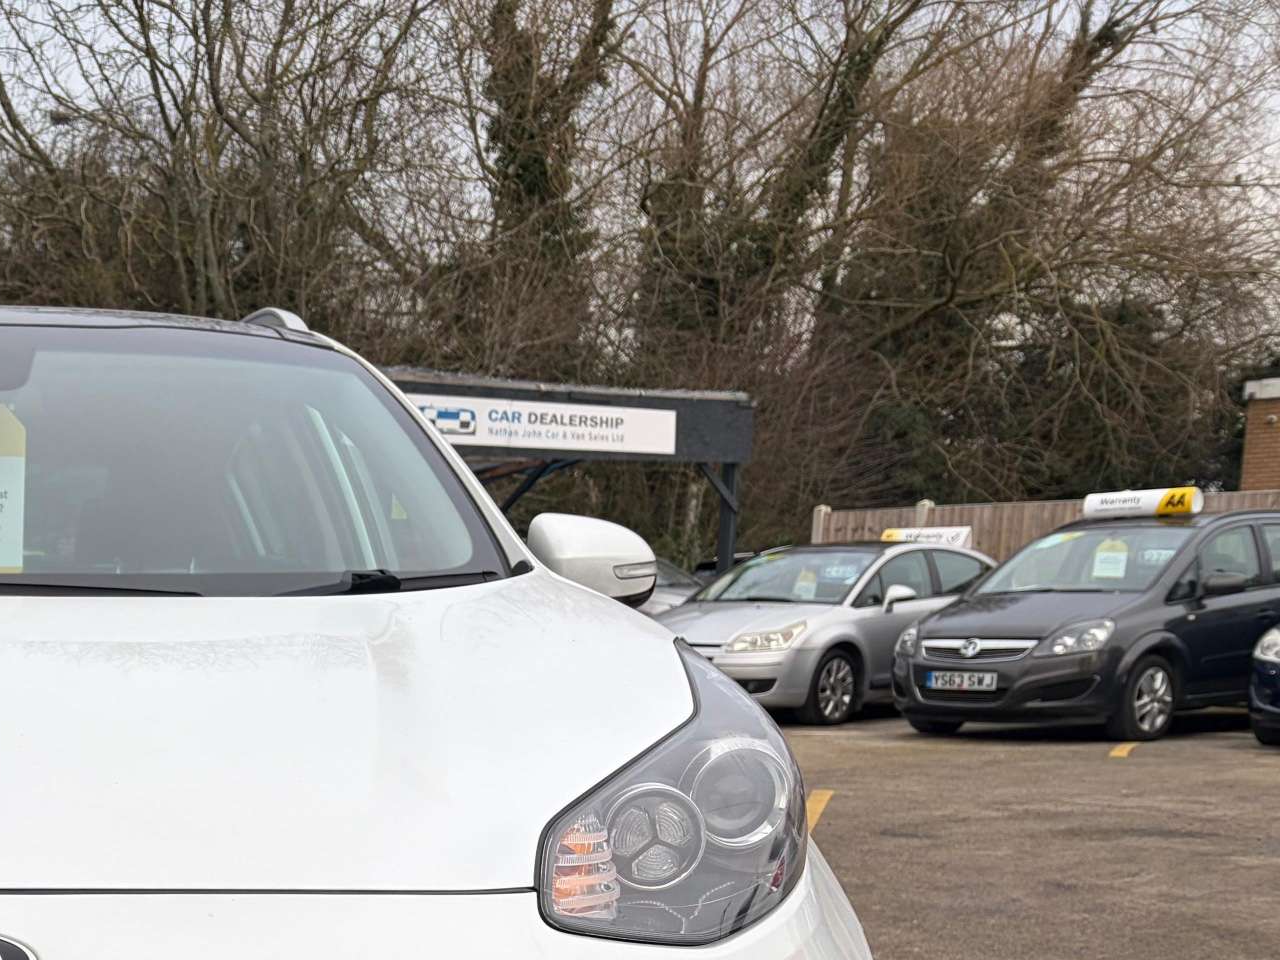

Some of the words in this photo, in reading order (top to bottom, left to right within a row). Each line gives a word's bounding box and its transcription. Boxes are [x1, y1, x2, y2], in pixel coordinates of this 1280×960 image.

[488, 409, 522, 424] CAR
[527, 411, 625, 429] DEALERSHIP
[1166, 492, 1188, 508] AA
